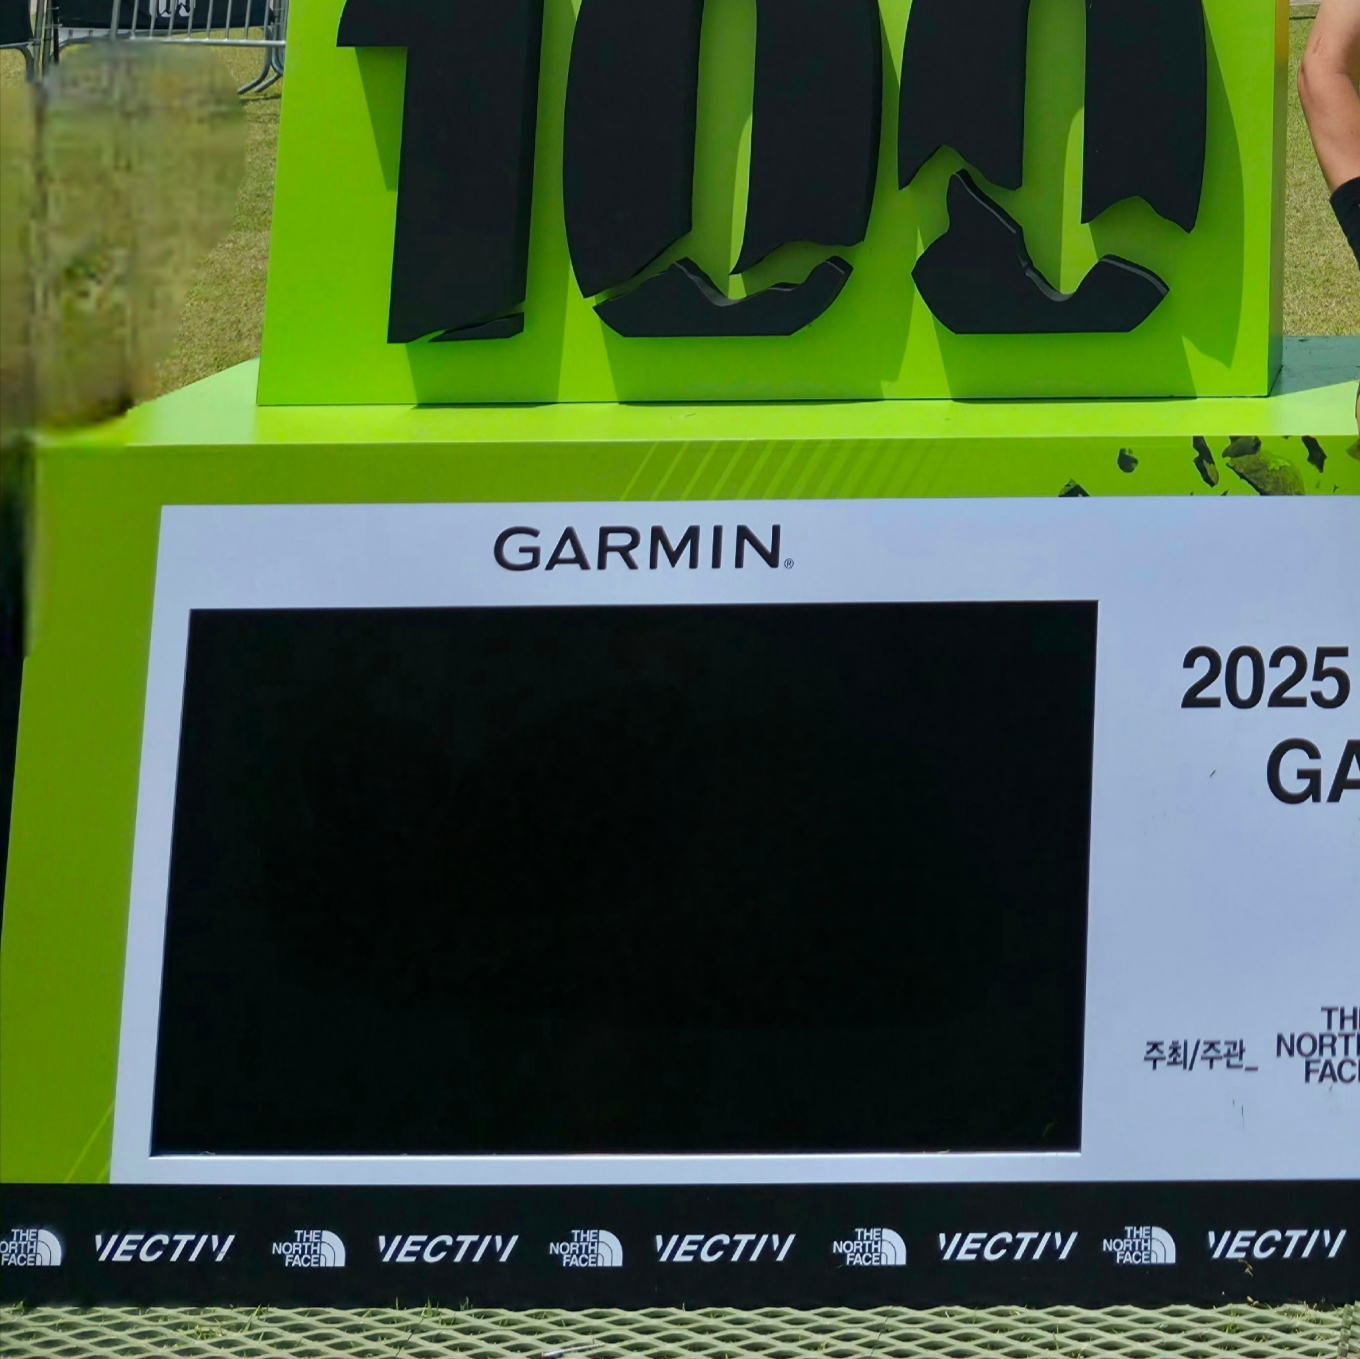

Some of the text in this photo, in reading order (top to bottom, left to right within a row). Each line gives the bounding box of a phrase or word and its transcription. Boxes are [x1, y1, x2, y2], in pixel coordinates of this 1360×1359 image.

[1181, 644, 1350, 709] 2025
[1143, 1038, 1258, 1071] 주최/주관_
[11, 1229, 38, 1241] THE
[293, 1229, 321, 1242] THE
[571, 1229, 599, 1242] THE
[854, 1227, 882, 1240] THE
[1124, 1225, 1152, 1238] THE
[0, 1240, 37, 1254] ORTH
[96, 1234, 234, 1262] VECTIV
[272, 1241, 321, 1255] NORTH
[379, 1234, 518, 1262] VECTIV
[550, 1241, 599, 1255] NORTH
[656, 1234, 795, 1262] VECTIV
[833, 1239, 882, 1253] NORTH
[939, 1232, 1078, 1261] VECTIV
[1103, 1237, 1152, 1251] NORTH
[1208, 1229, 1346, 1260] VECTIV
[1, 1253, 36, 1266] FACE
[285, 1253, 321, 1267] FACE
[563, 1253, 599, 1267] FACE
[846, 1251, 882, 1265] FACE
[1116, 1249, 1152, 1263] FACE
